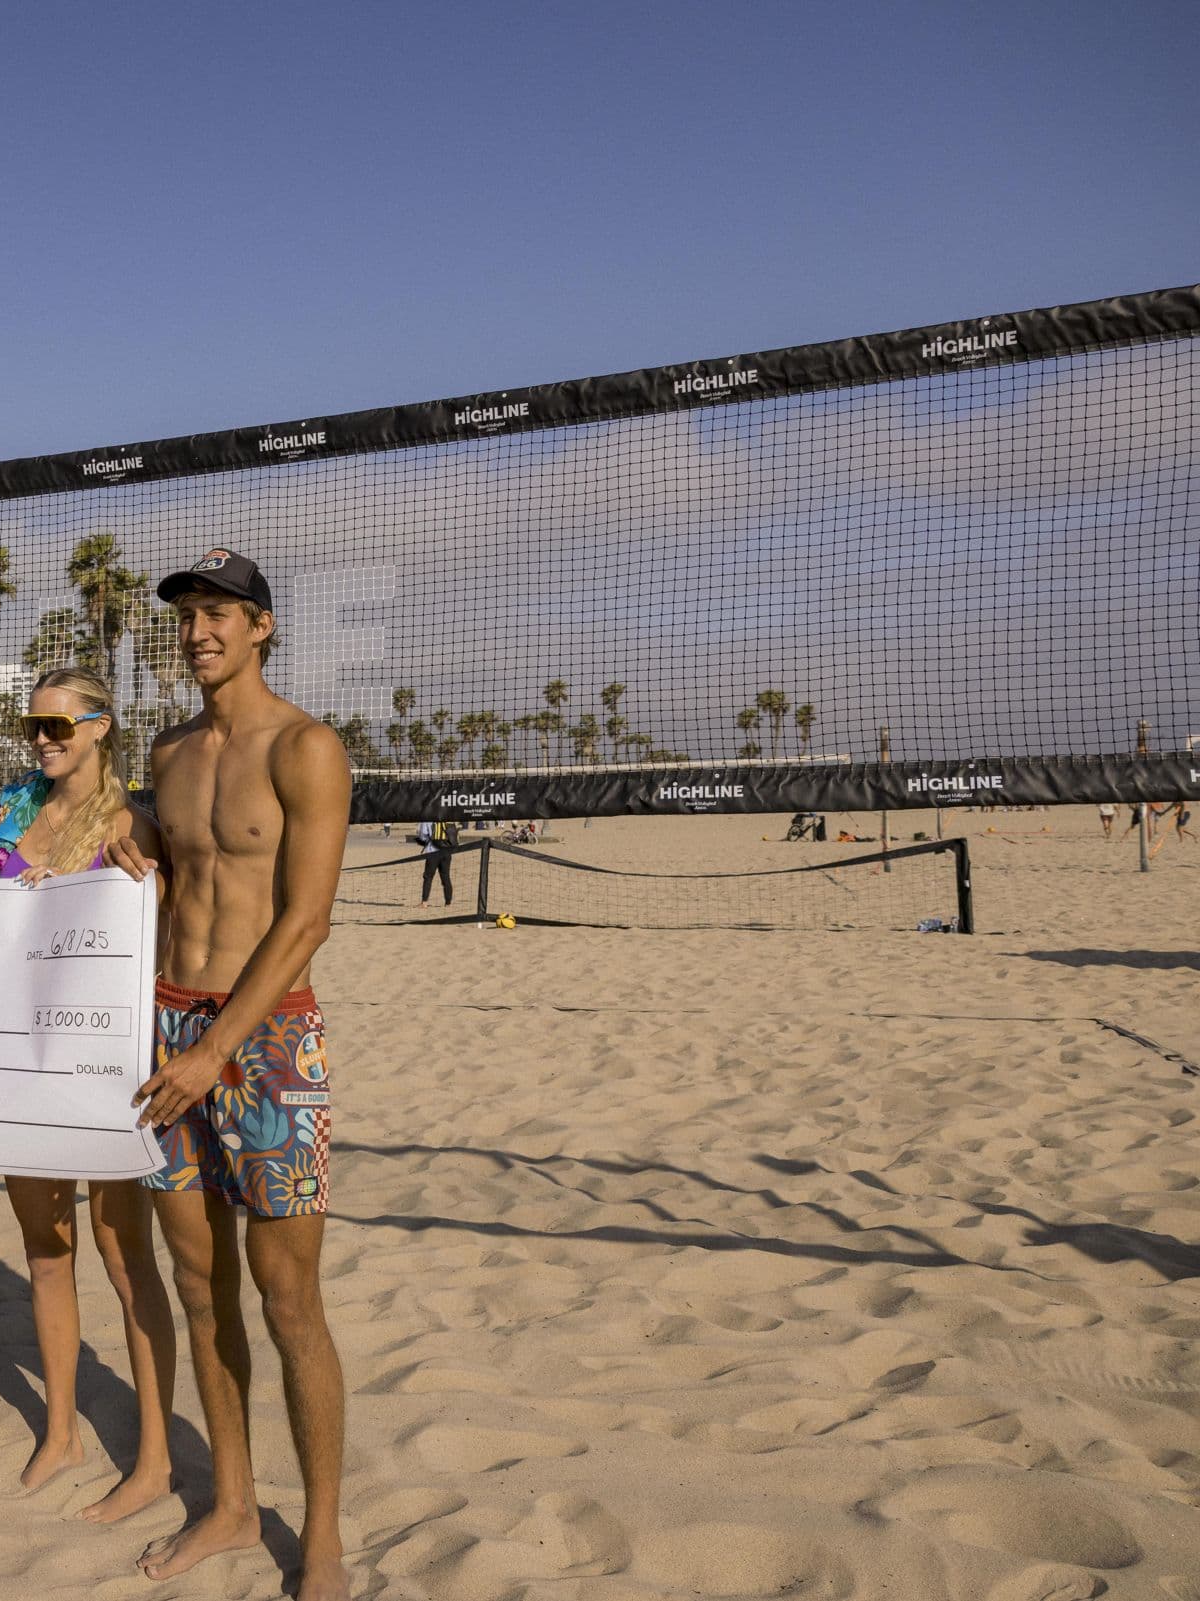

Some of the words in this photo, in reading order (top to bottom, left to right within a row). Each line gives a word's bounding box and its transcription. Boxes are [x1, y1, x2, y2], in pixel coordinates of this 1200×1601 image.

[27, 950, 44, 960] DATE
[51, 928, 109, 956] 6/8/25
[76, 1064, 123, 1076] DOLLARS
